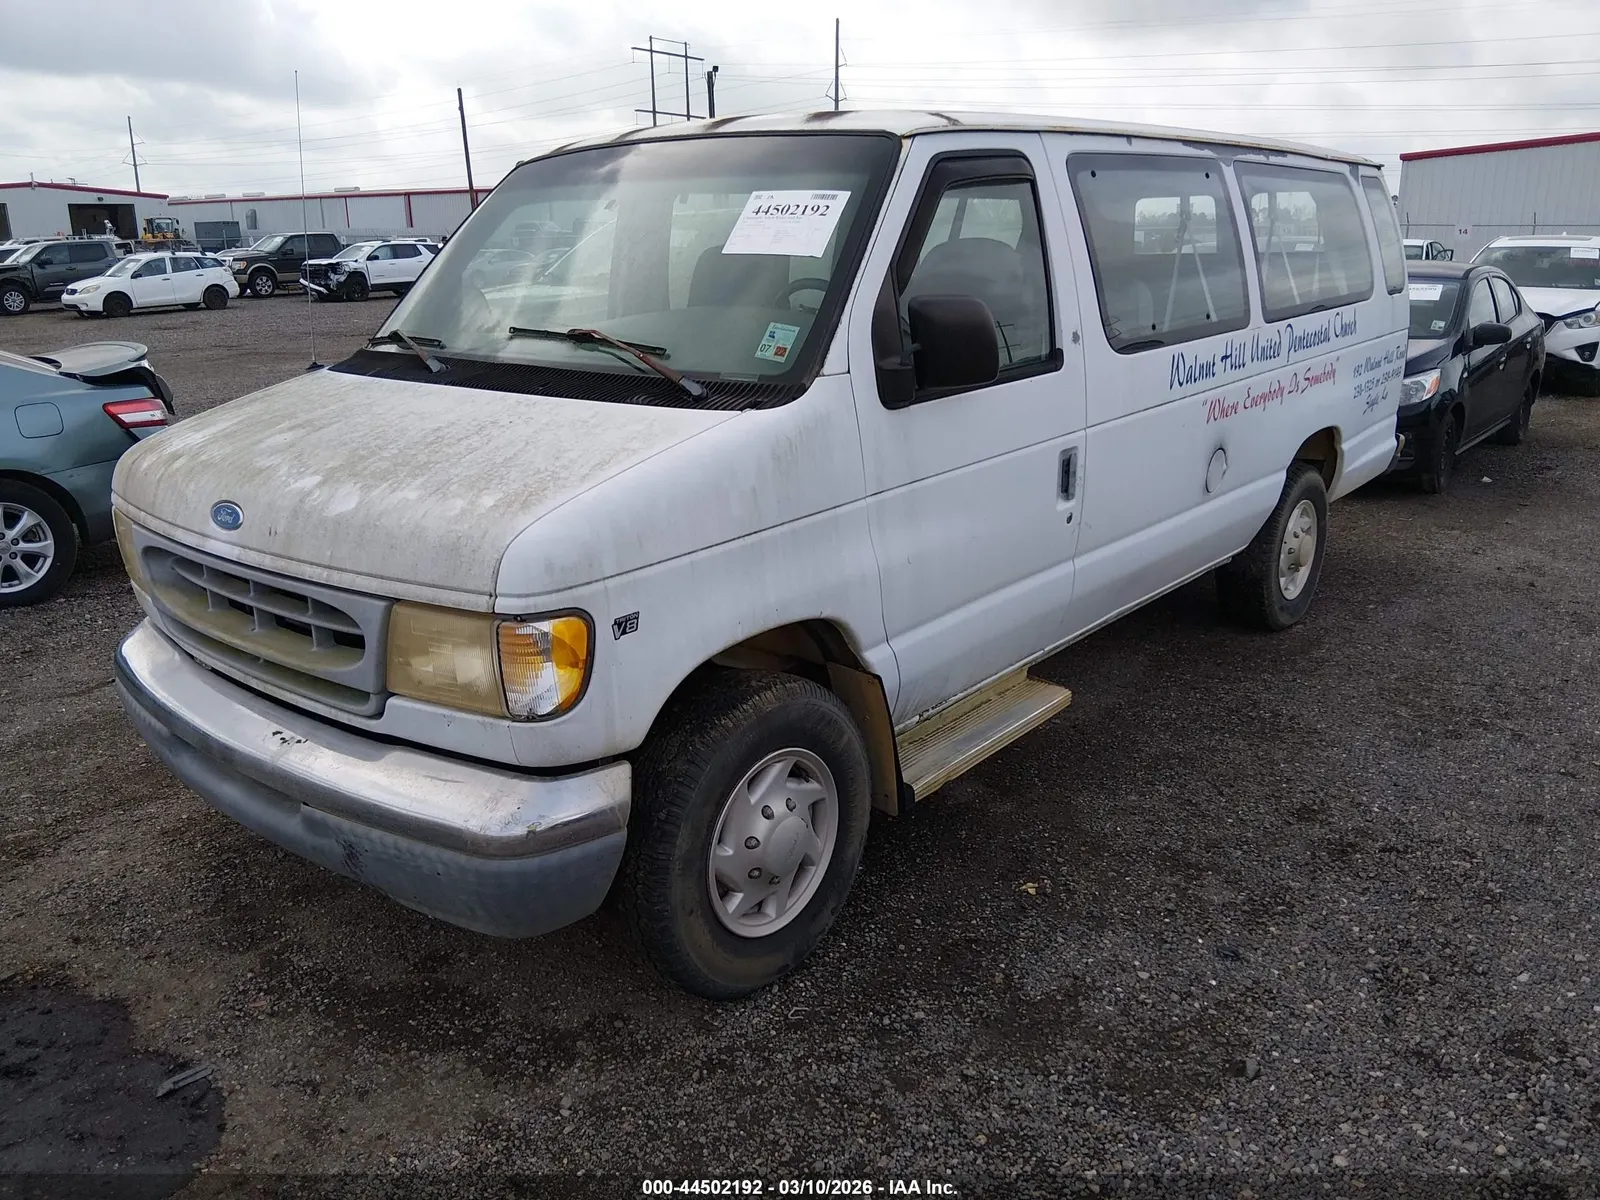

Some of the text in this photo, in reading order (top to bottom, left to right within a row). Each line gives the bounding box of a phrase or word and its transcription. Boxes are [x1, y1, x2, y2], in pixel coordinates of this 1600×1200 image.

[752, 203, 831, 217] 44502192
[759, 343, 772, 353] 07
[1169, 308, 1357, 391] Walnut Hill United Pentecostal Church
[1363, 356, 1382, 374] Walnut
[1383, 349, 1395, 366] Hill
[1243, 386, 1285, 411] Everybody
[1287, 372, 1300, 395] Is
[216, 507, 236, 524] Ford
[612, 619, 638, 640] V8
